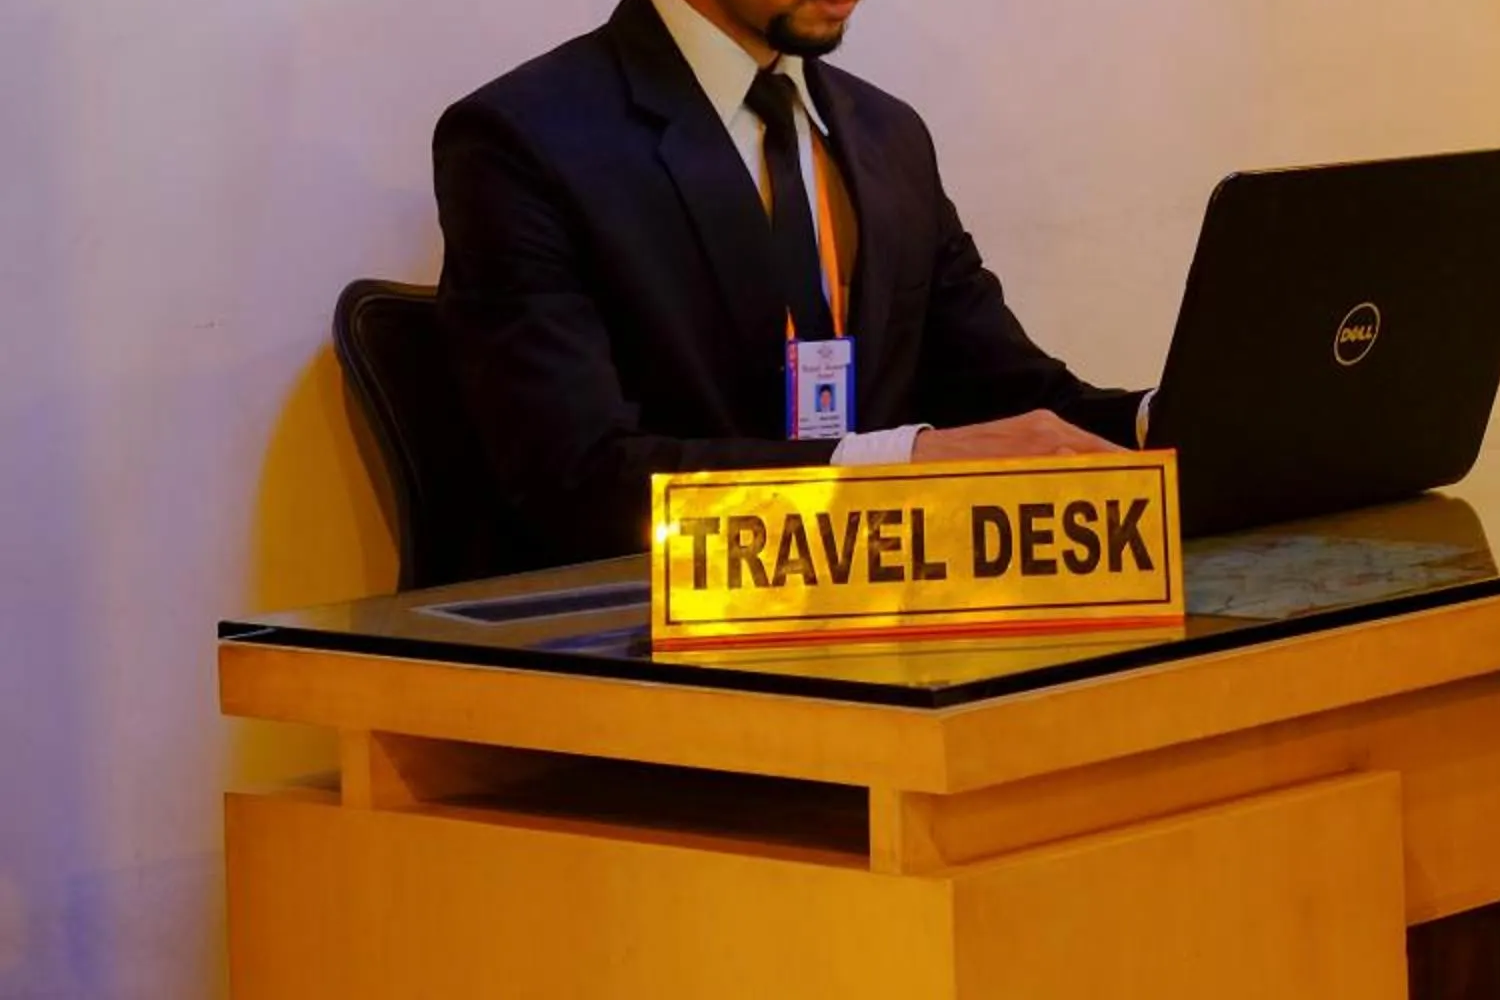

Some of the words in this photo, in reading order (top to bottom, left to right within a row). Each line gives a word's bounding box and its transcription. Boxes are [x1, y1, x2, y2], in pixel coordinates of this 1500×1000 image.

[1340, 325, 1373, 343] DELL
[680, 508, 947, 590] TRAVEL
[971, 498, 1155, 580] DESK
